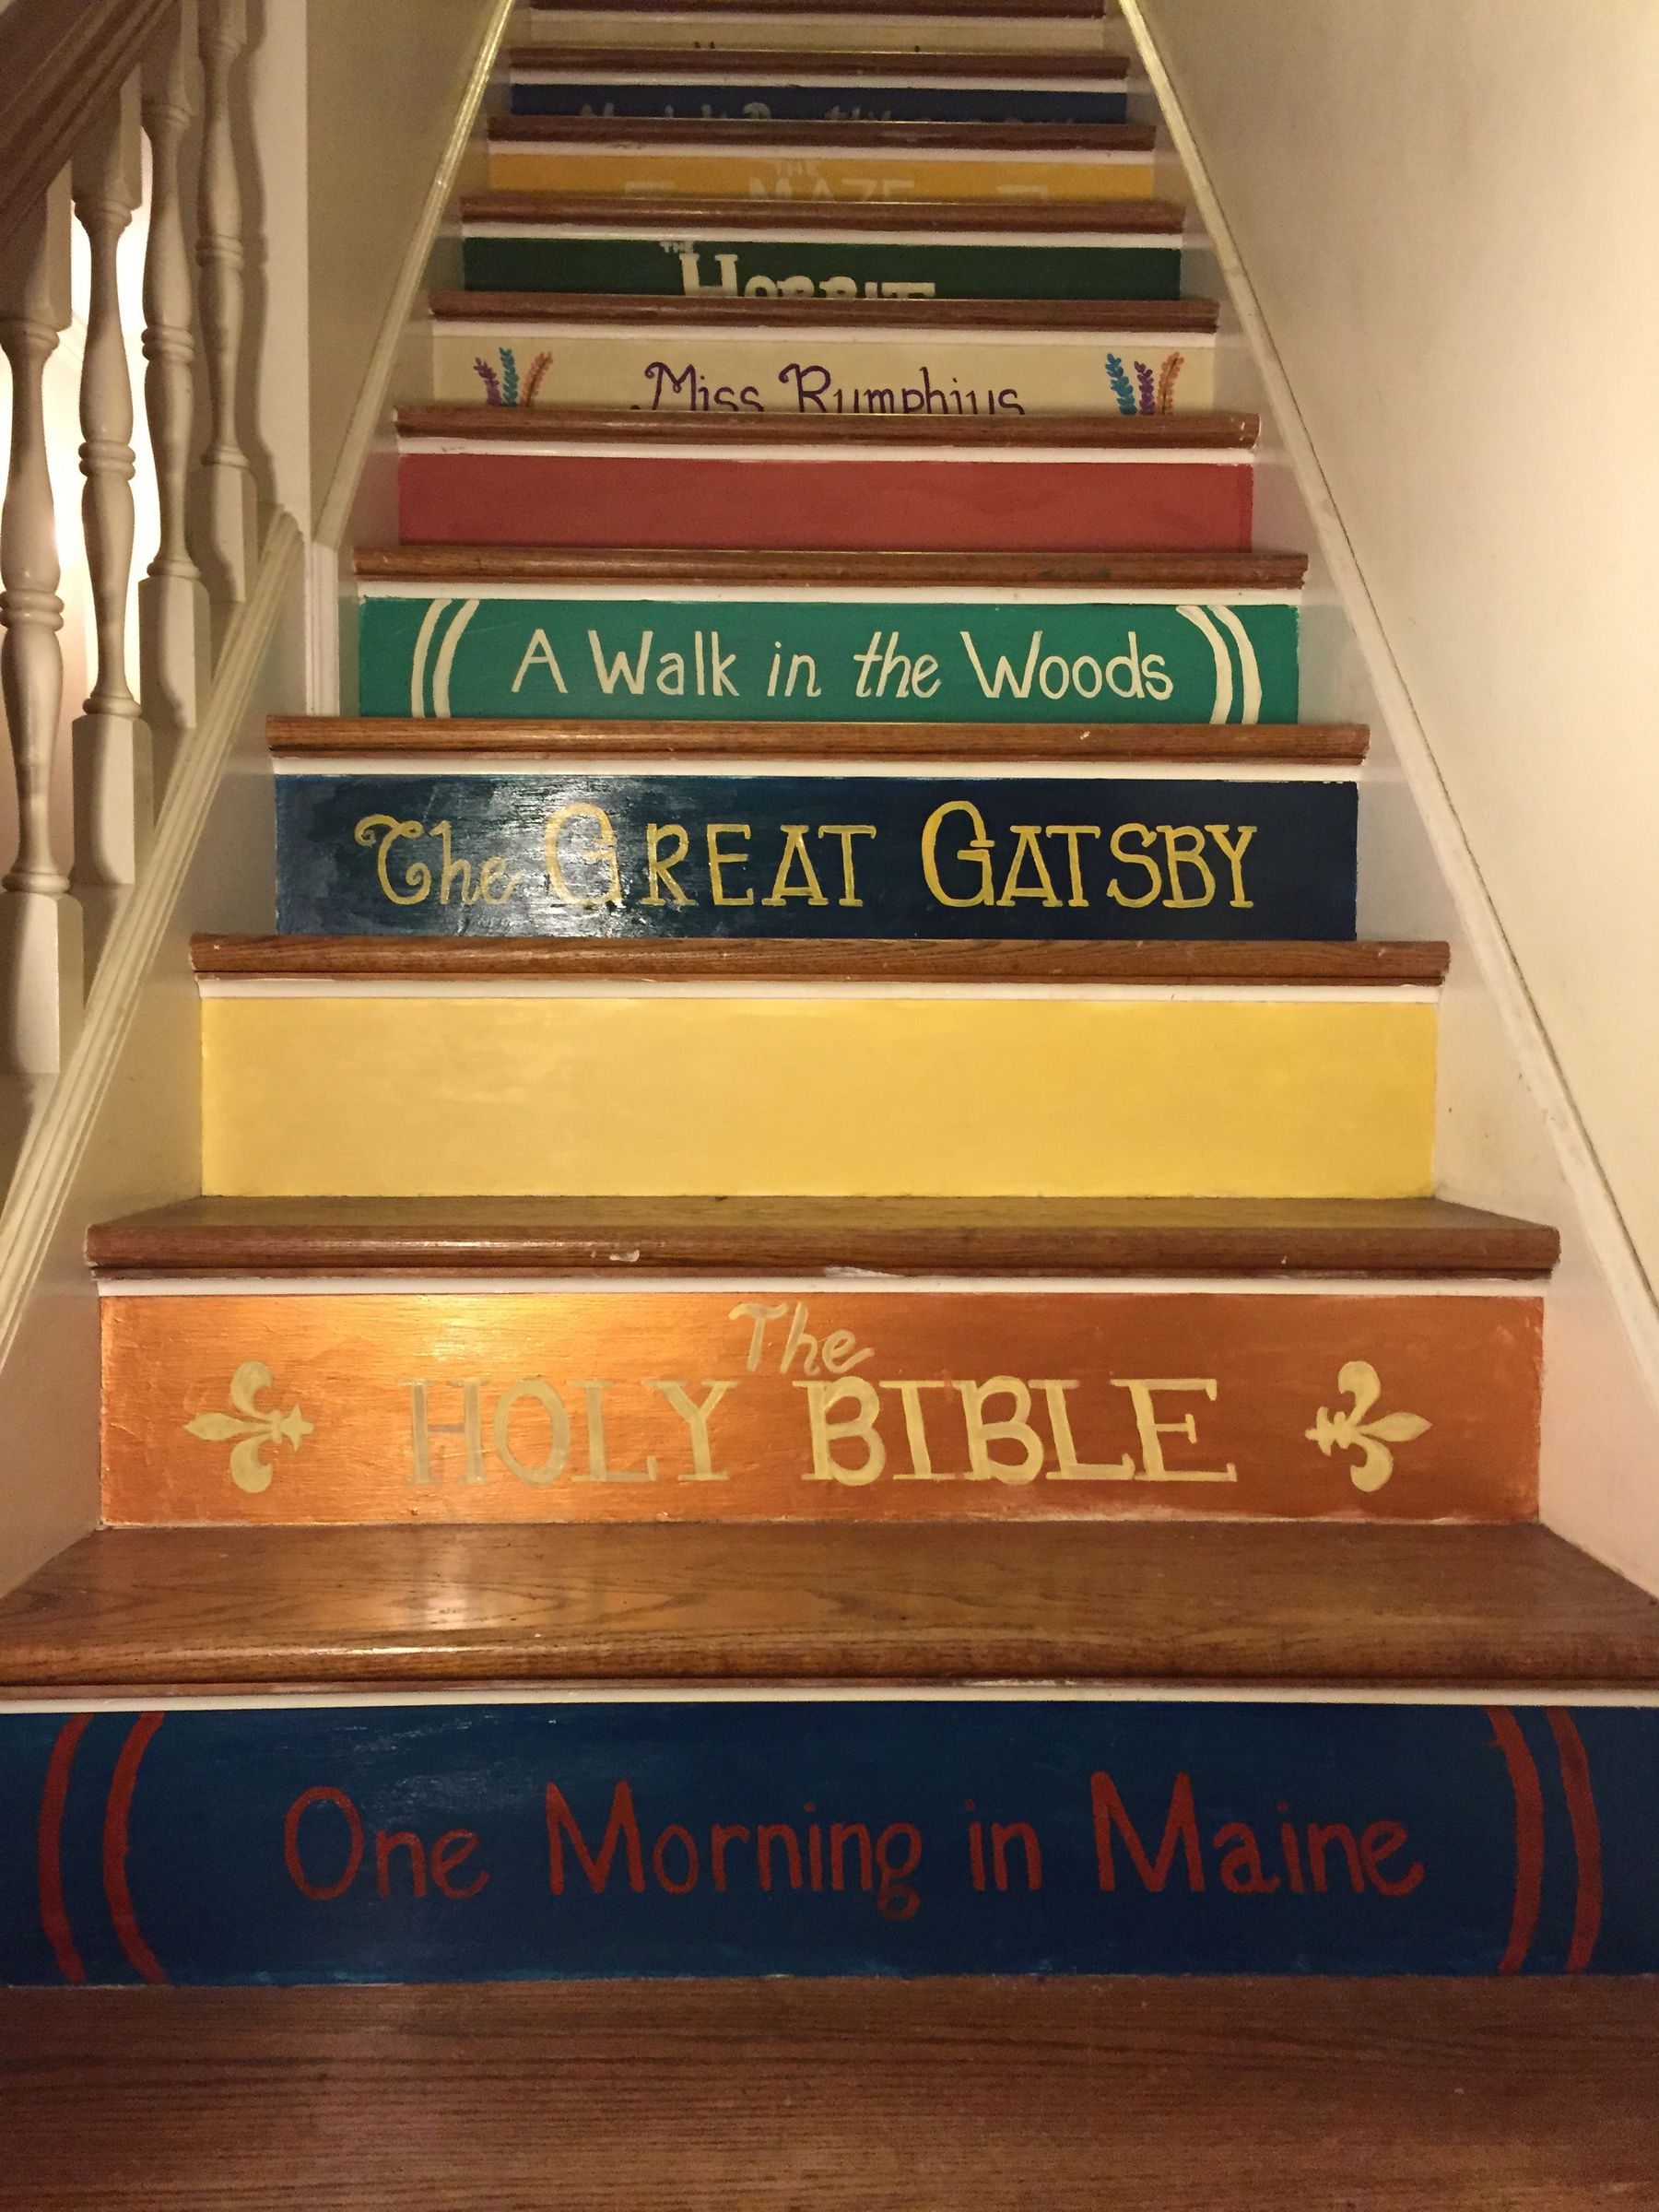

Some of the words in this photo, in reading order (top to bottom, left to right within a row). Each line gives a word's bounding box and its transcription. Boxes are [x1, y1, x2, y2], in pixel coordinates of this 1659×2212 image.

[771, 159, 818, 176] THE
[644, 362, 764, 412] Miss
[778, 363, 1027, 415] Rumphius
[511, 629, 567, 695] A
[587, 629, 738, 698] Walk
[767, 641, 822, 698] in
[853, 630, 941, 700] the
[960, 630, 1174, 701] Woods
[354, 814, 522, 906] The
[544, 800, 877, 909] GREAT
[920, 800, 1258, 909] GATSBY
[728, 1300, 877, 1376] The
[398, 1377, 738, 1487] HOLY
[793, 1373, 1239, 1488] BIBLE
[283, 1784, 490, 1902] One
[544, 1779, 924, 1922] Morning
[964, 1797, 1044, 1893] in
[1088, 1771, 1426, 1899] Maine
